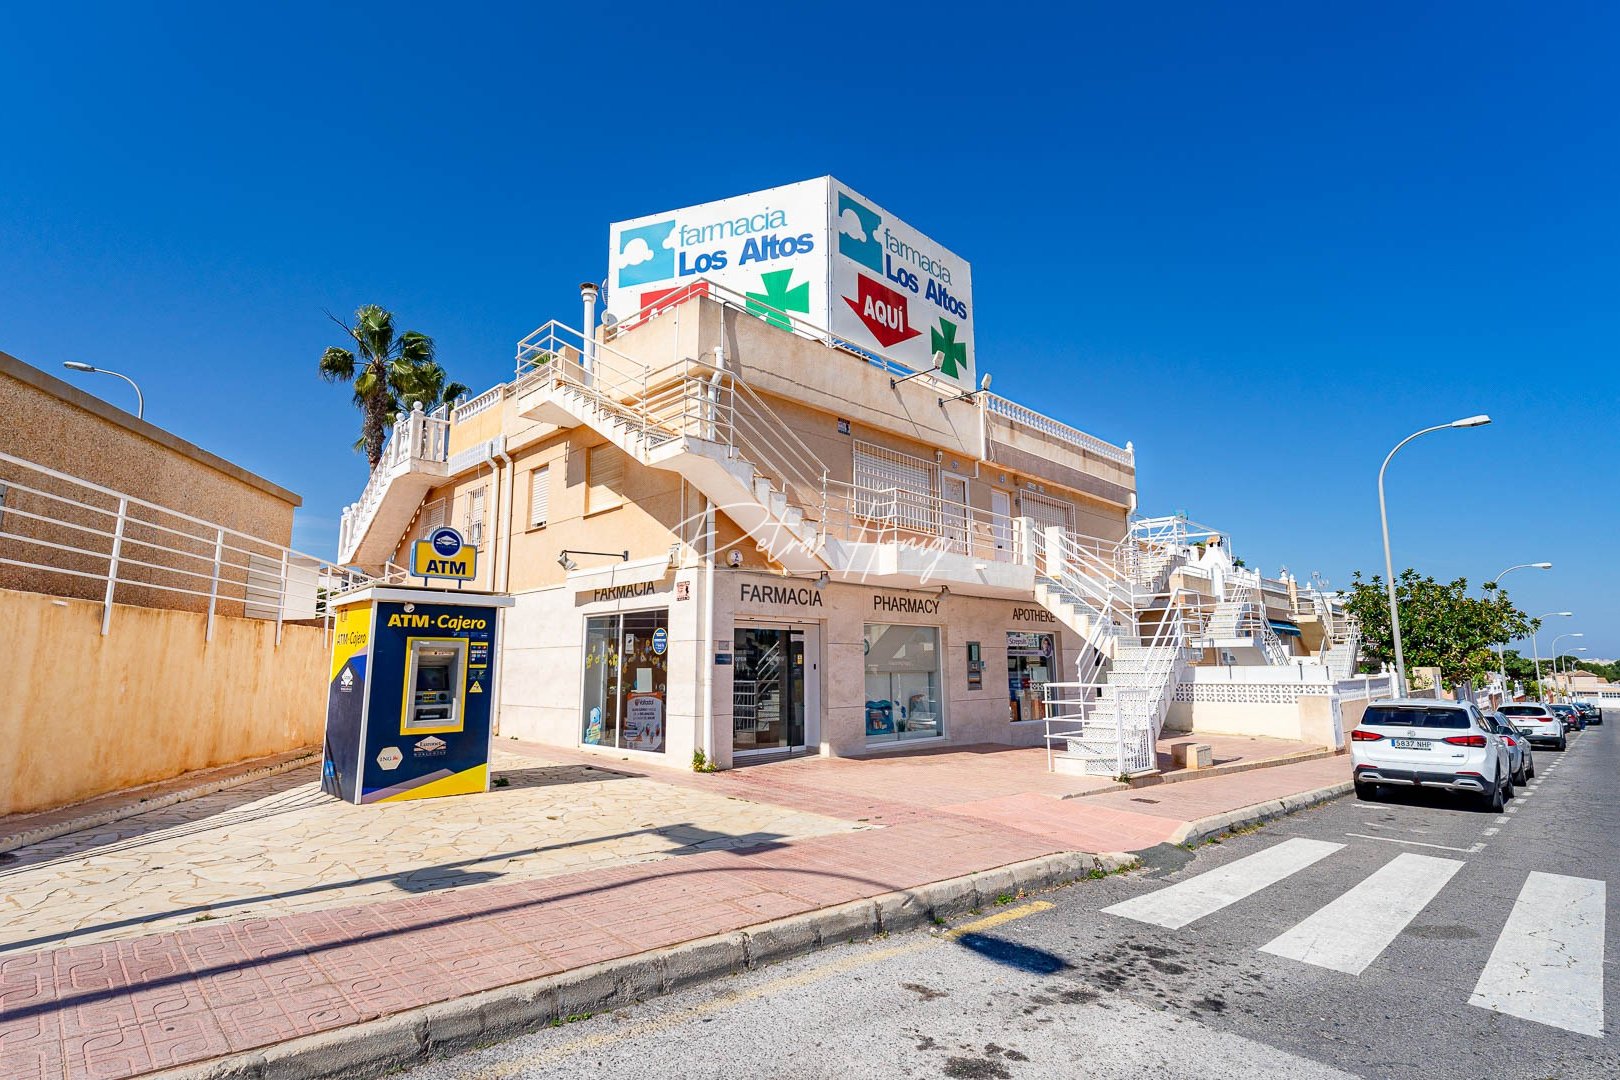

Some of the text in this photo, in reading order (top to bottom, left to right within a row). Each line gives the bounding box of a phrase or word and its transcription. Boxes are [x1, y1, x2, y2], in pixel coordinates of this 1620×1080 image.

[680, 206, 788, 248] farmacia
[679, 231, 814, 277] Los Altos
[883, 227, 953, 286] farmacia
[886, 253, 967, 320] Los Altos
[863, 301, 904, 333] AQUÍ
[425, 559, 466, 575] ATM
[594, 581, 655, 602] FARMACIA
[740, 583, 823, 607] FARMACIA
[874, 595, 940, 615] PHARMACY
[1012, 608, 1056, 623] APOTHEKE
[1396, 739, 1414, 747] 5837
